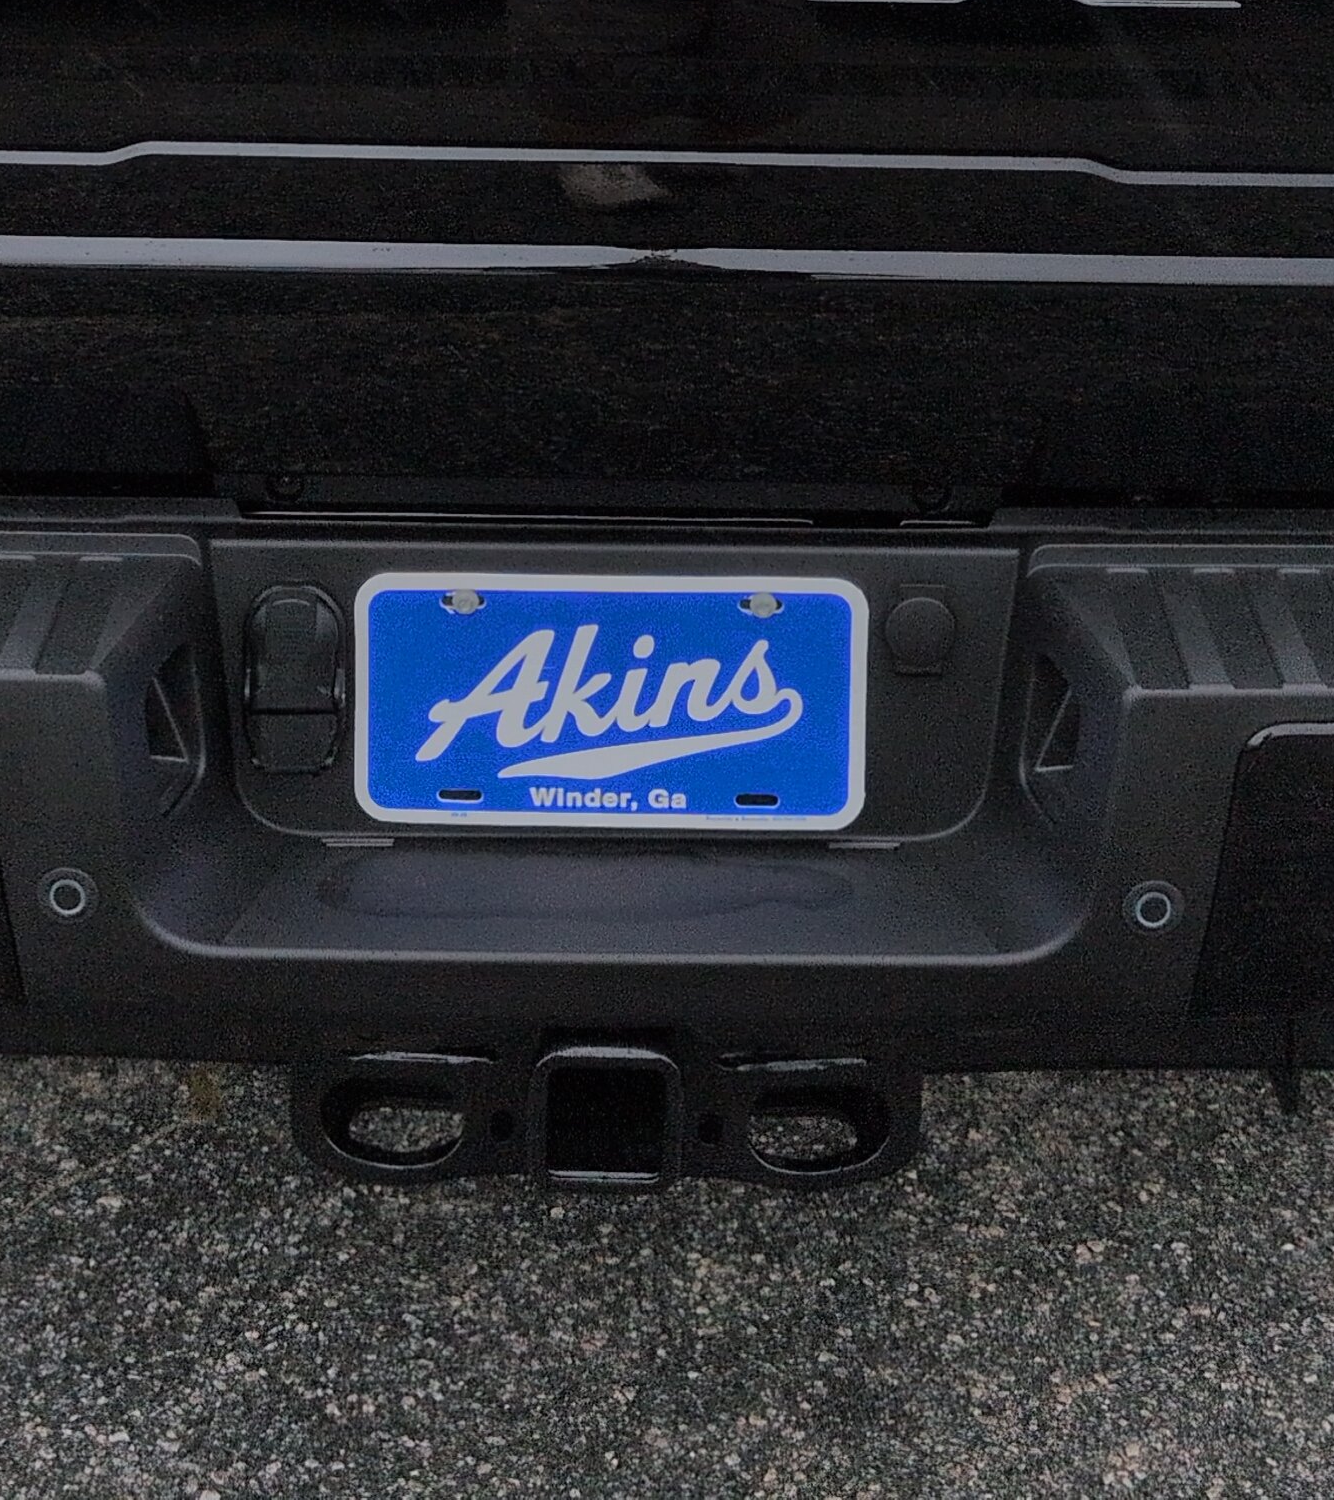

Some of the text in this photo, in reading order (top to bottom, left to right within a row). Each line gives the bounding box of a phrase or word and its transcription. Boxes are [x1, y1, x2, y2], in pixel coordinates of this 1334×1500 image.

[415, 623, 804, 770] Akins
[528, 786, 688, 812] Winder, Ga
